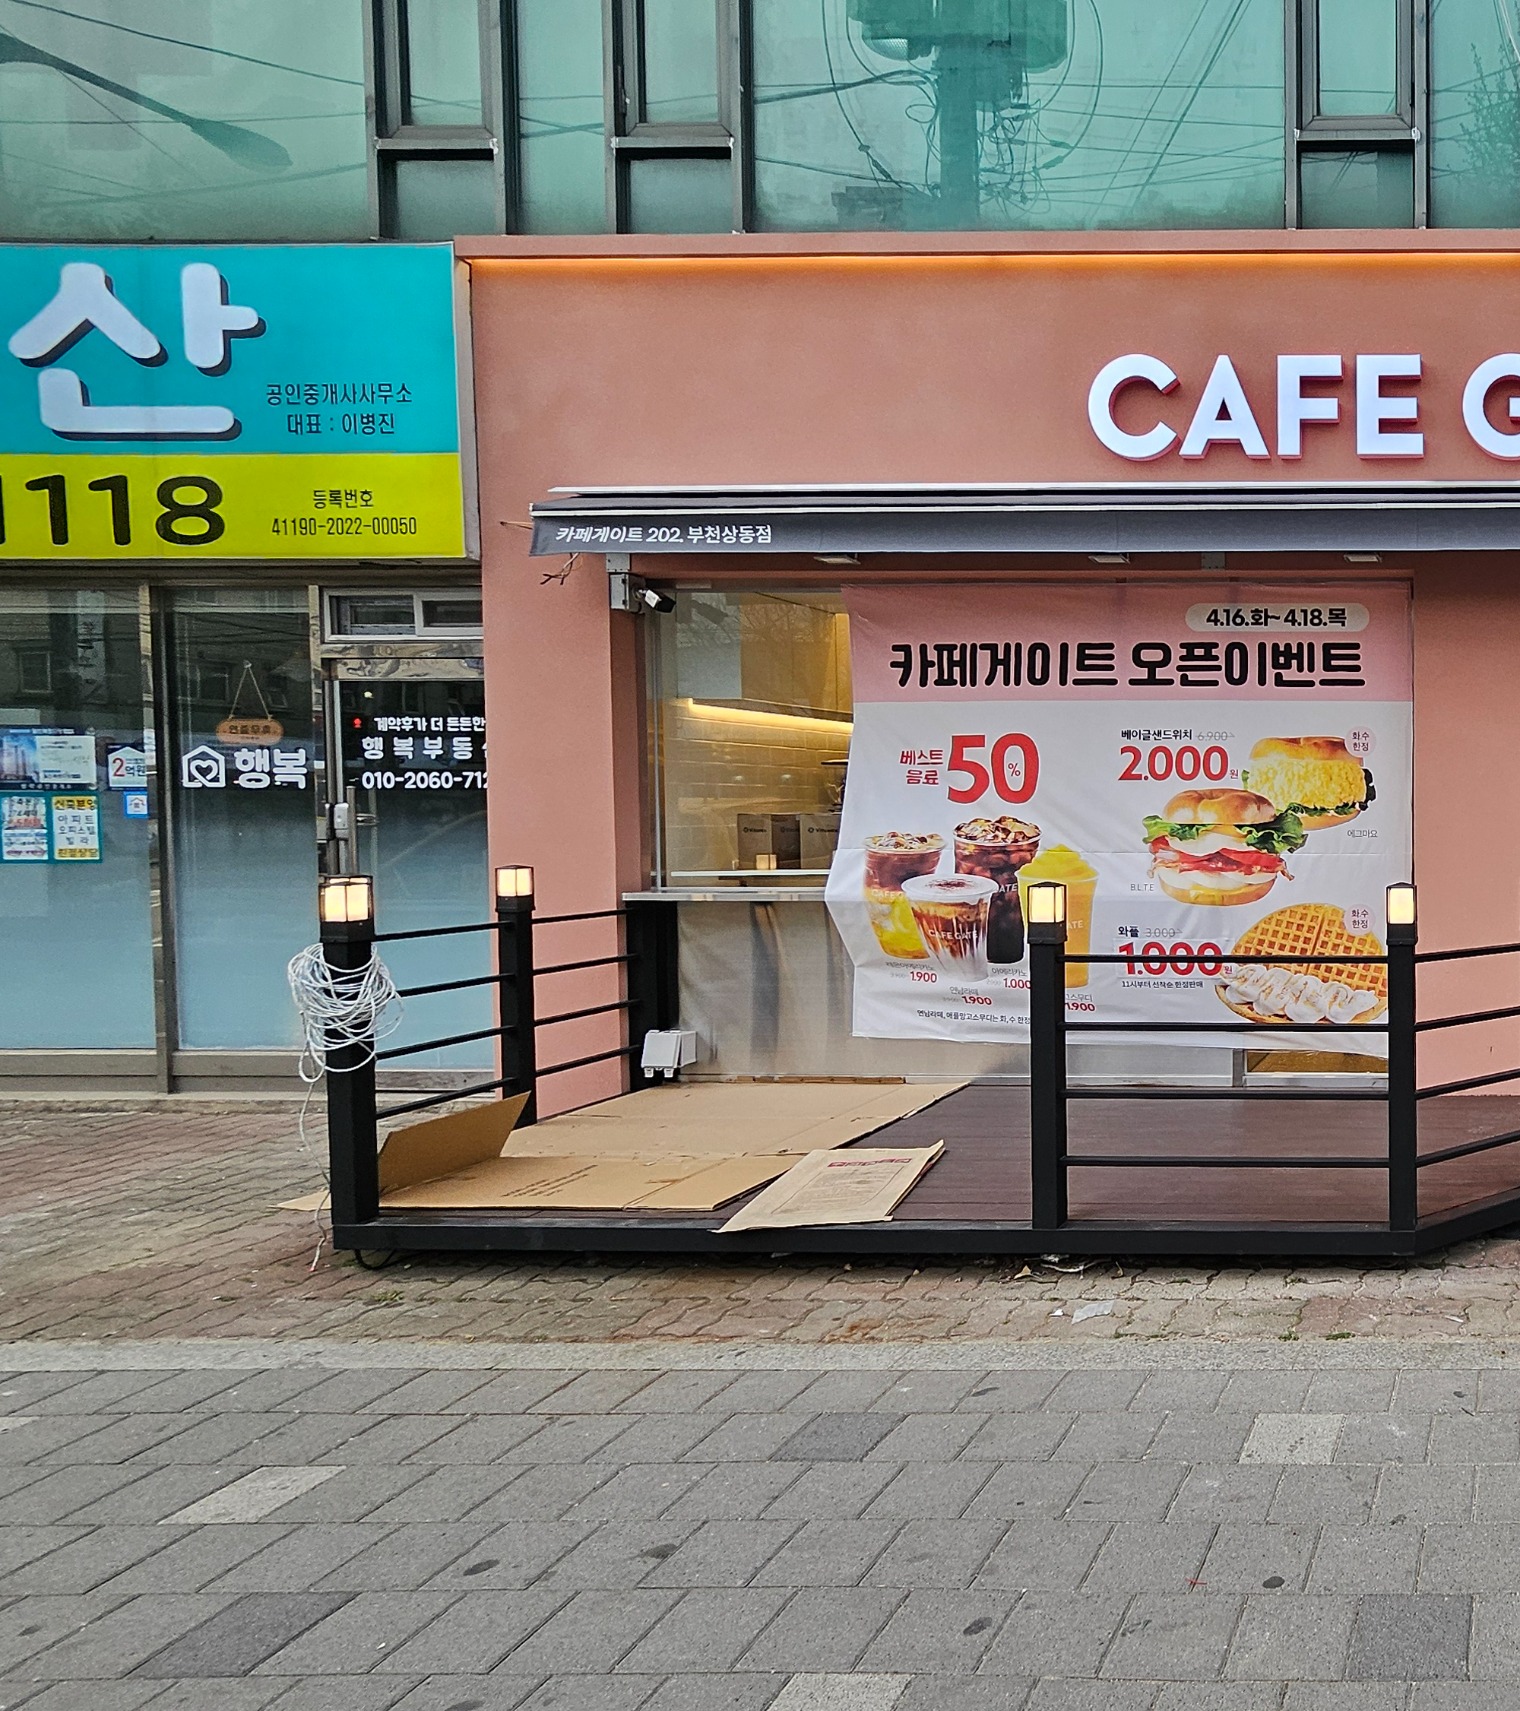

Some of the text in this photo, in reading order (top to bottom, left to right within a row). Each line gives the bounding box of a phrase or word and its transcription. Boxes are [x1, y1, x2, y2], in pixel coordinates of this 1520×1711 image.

[8, 262, 260, 436] 산
[266, 383, 412, 404] 공인중개사사무소
[1087, 352, 1425, 460] CAFE
[287, 413, 322, 435] 대표
[341, 413, 396, 435] 이병진
[313, 489, 374, 509] 등록번호
[0, 474, 226, 546] 118
[271, 517, 418, 536] 41190-2022-00050
[556, 525, 772, 543] 카페게이트 202. 부천상동점
[889, 640, 1367, 688] 카페게이트 오픈이벤트
[374, 716, 428, 731] 계약후가
[431, 717, 443, 731] 더
[1353, 742, 1369, 751] 한정
[900, 750, 943, 765] 베스트
[1118, 746, 1229, 781] 2.000
[233, 748, 308, 789] 행복
[906, 769, 940, 785] 음료
[947, 733, 1039, 804] 50
[1229, 769, 1239, 779] 원
[1347, 829, 1378, 838] 에그마요
[996, 882, 1018, 894] ATE
[1118, 926, 1139, 938] 와플
[1352, 920, 1368, 929] 한정
[928, 928, 953, 941] CAFE
[1118, 941, 1223, 976] 1.000
